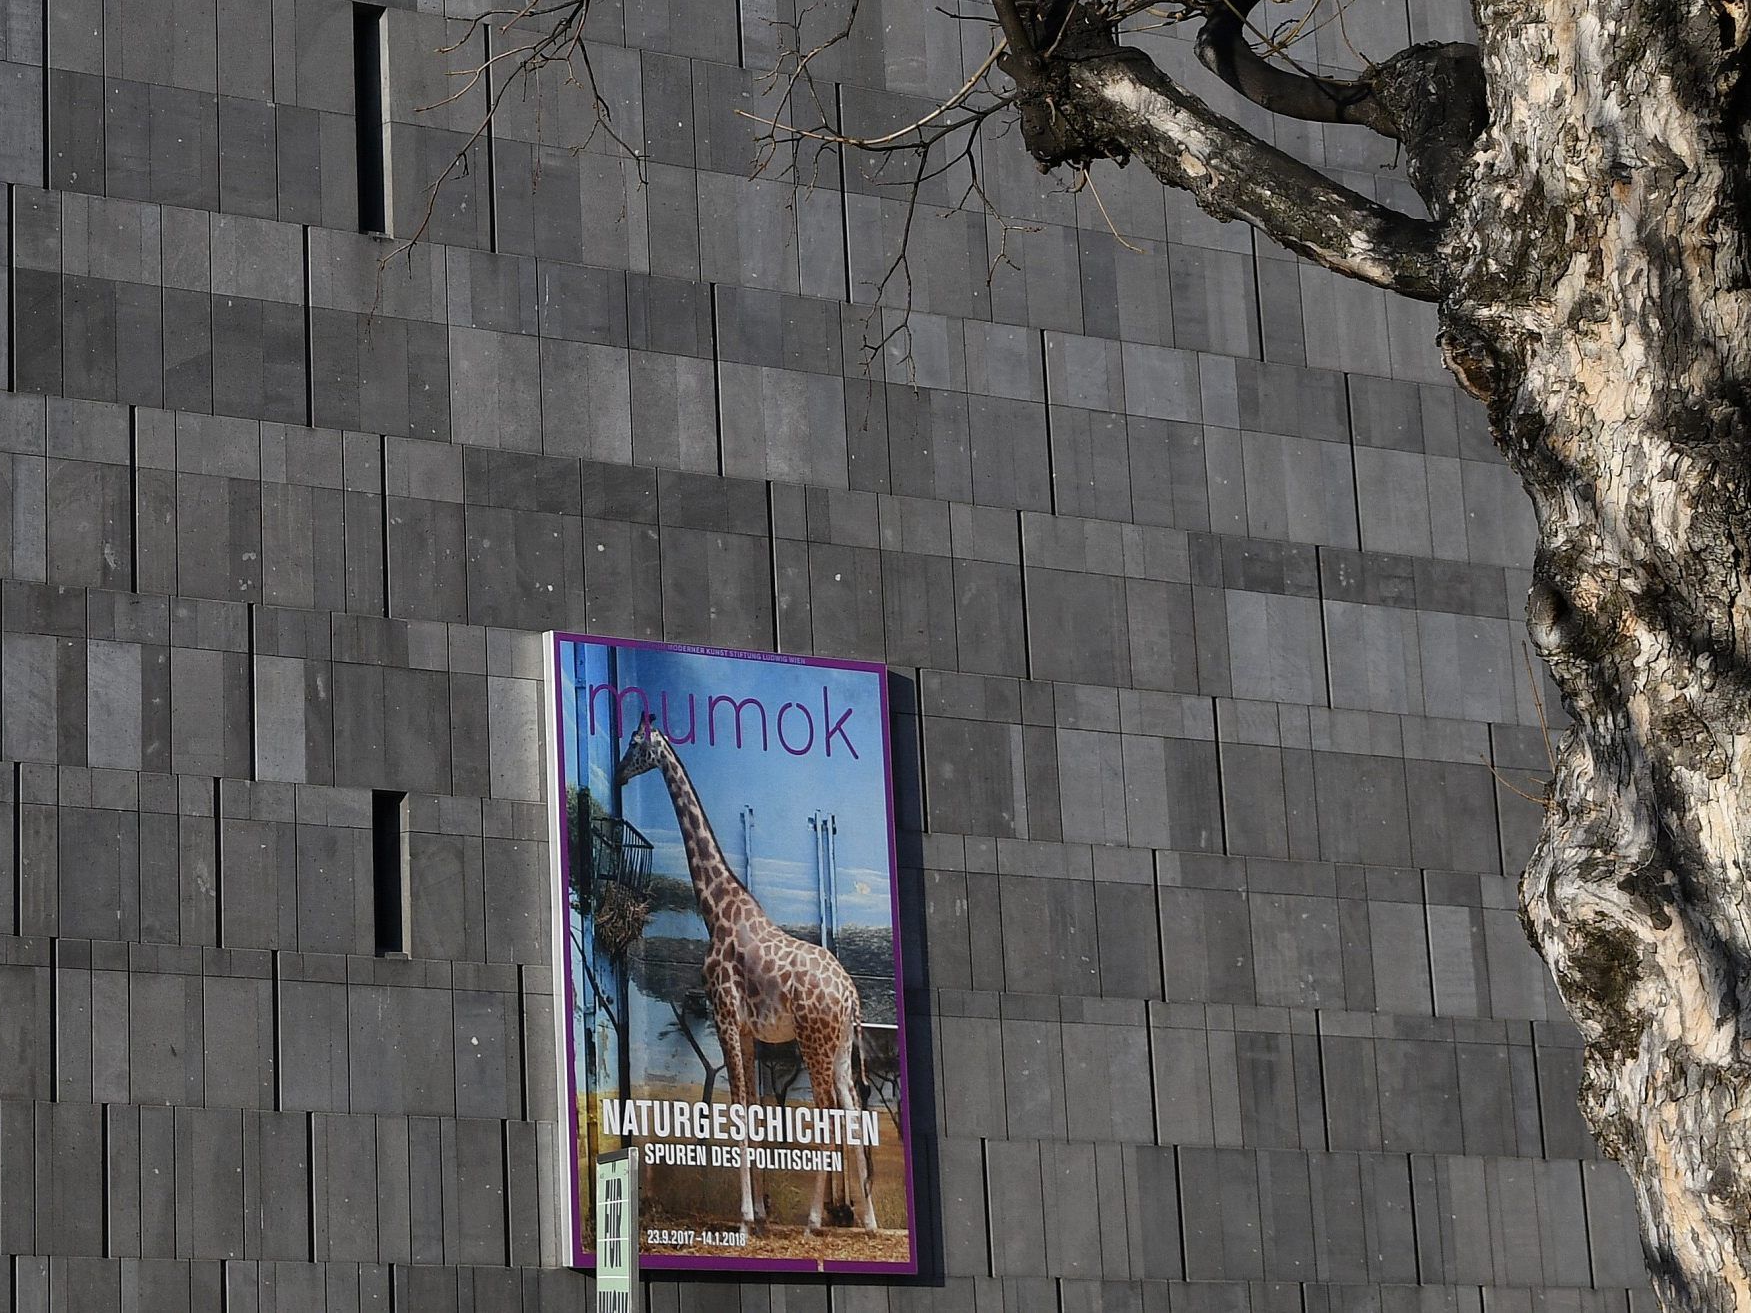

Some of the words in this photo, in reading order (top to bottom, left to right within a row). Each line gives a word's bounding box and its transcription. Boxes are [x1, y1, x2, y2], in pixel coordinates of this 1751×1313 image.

[706, 648, 728, 656] KUNST
[729, 650, 762, 660] STIFTUNG
[762, 654, 788, 663] LUDWIG
[789, 656, 806, 665] WIEN
[588, 684, 860, 760] mumok
[601, 1099, 880, 1146] NATURGESCHICHTEN
[644, 1142, 707, 1166] SPUREN
[712, 1146, 741, 1168] DES
[746, 1147, 843, 1172] POLITISCHEN
